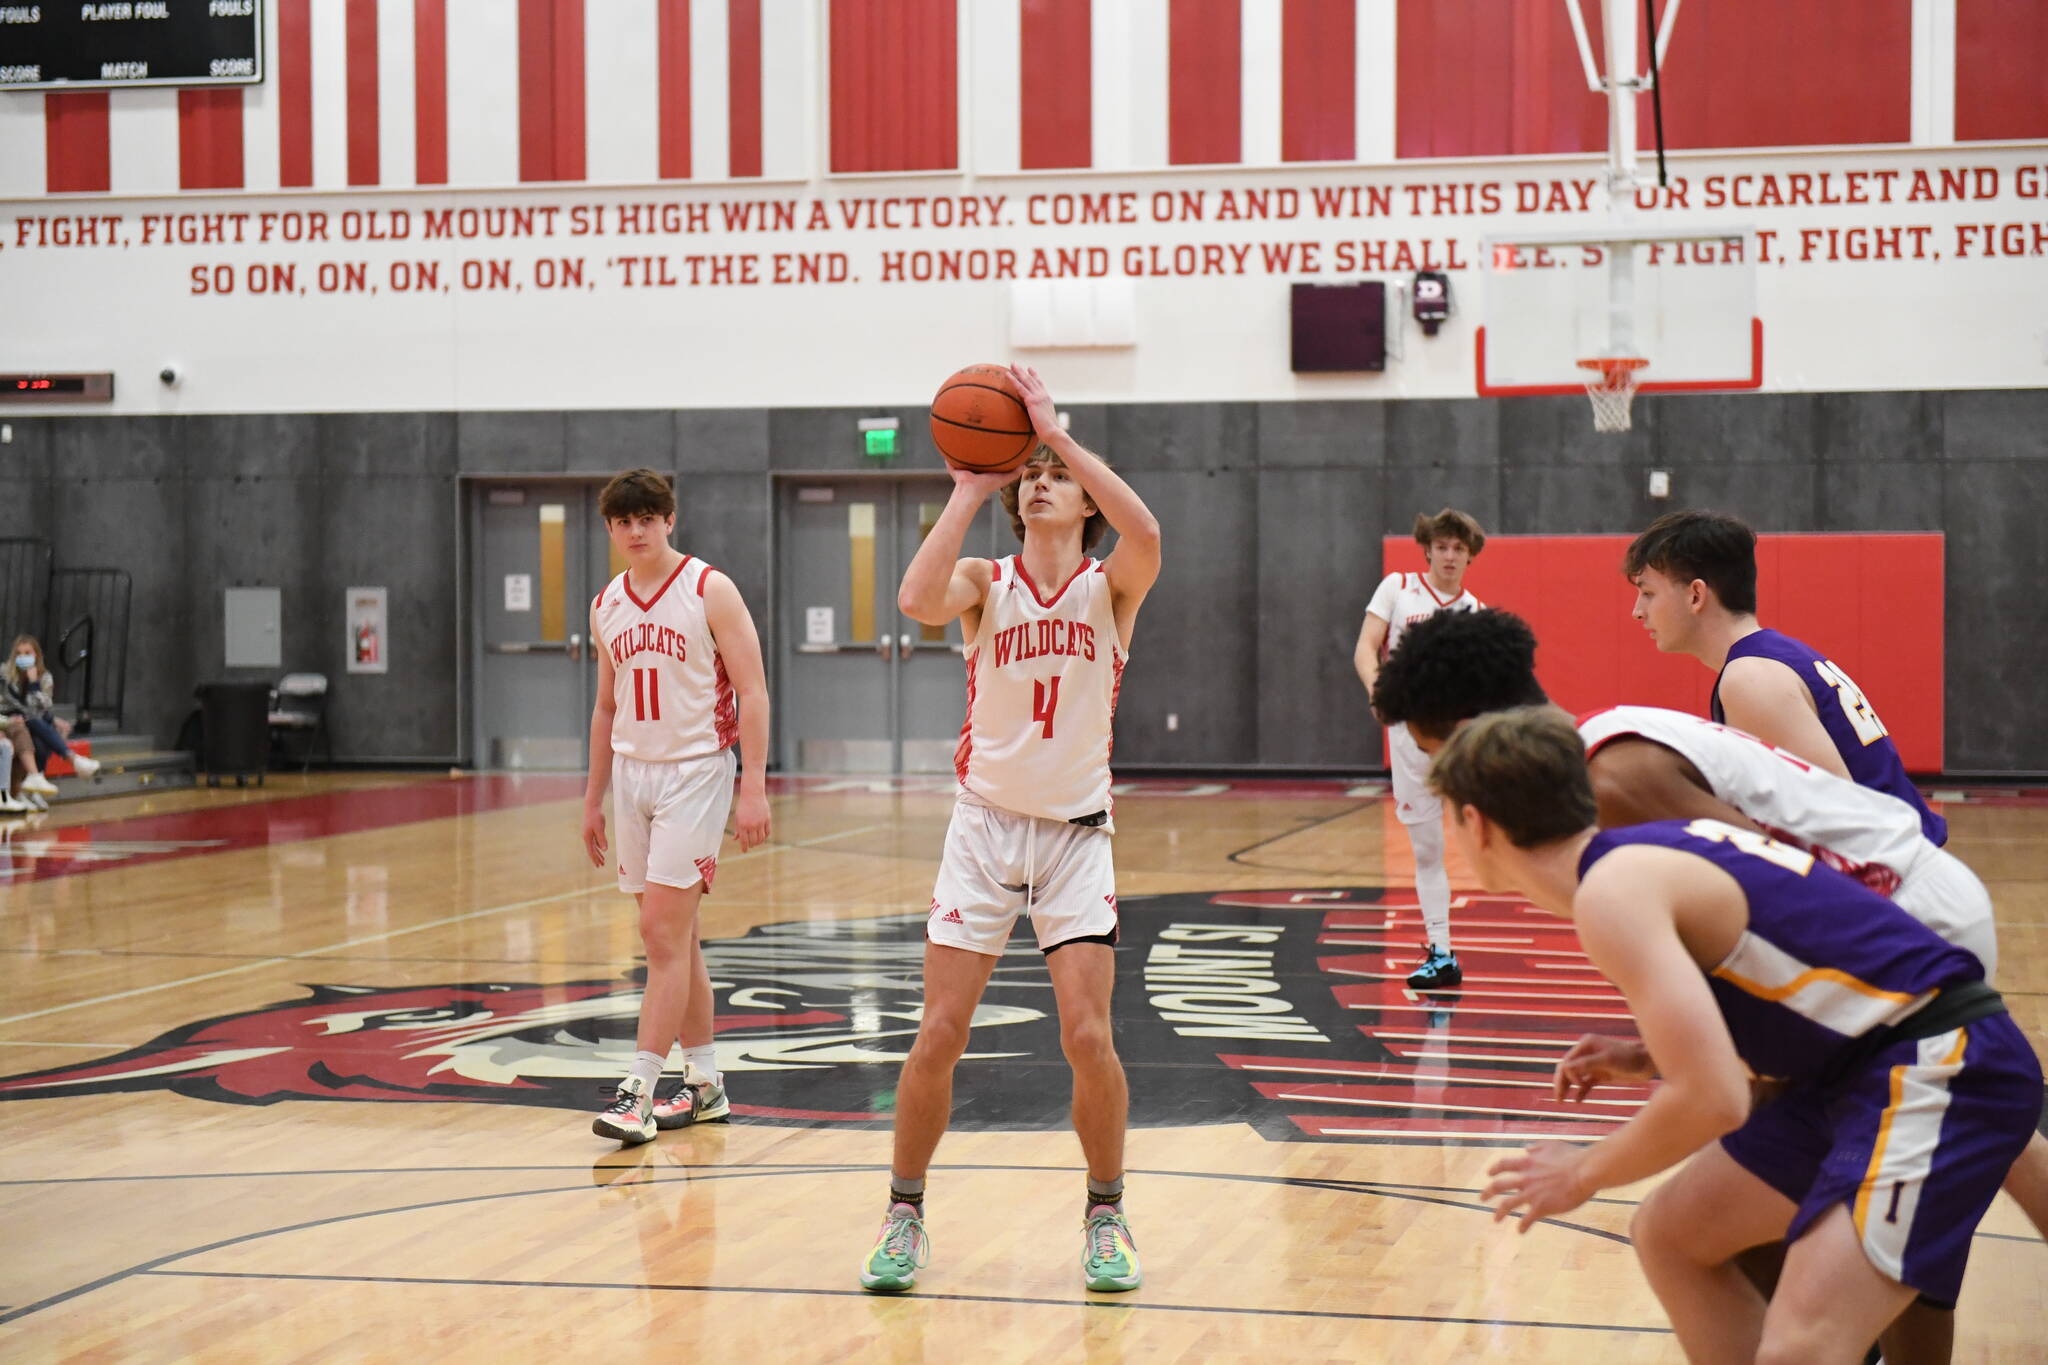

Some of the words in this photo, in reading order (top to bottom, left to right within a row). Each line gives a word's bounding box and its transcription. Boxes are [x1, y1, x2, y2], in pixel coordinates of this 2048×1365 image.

[0, 5, 41, 24] FOULS
[81, 3, 132, 22] PLAYER
[135, 1, 170, 20] FOUL
[208, 0, 254, 17] FOULS
[0, 64, 42, 83] SCORE
[101, 61, 149, 80] MATCH
[209, 58, 255, 78] SCORE
[15, 215, 129, 248] FIGHT,
[141, 213, 249, 245] FIGHT
[259, 211, 329, 242] FOR
[341, 209, 411, 241] OLD
[423, 206, 561, 240] MOUNT
[570, 204, 605, 236] SI
[617, 203, 710, 235] HIGH
[720, 200, 797, 233] WIN
[806, 200, 838, 231] A
[838, 195, 1015, 230] VICTORY.
[1027, 192, 1137, 225] COME
[1151, 190, 1205, 222] ON
[1215, 188, 1300, 221] AND
[1311, 186, 1393, 218] WIN
[1403, 182, 1502, 217] THIS
[1515, 180, 1597, 213] DAY
[1703, 170, 1900, 208] SCARLET
[1907, 166, 2000, 202] AND
[2015, 165, 2048, 199] G
[191, 264, 235, 295] SO
[246, 263, 306, 295] ON,
[318, 263, 378, 293] ON,
[389, 262, 450, 292] ON,
[462, 260, 522, 290] ON,
[534, 258, 594, 289] ON,
[684, 254, 760, 286] THE
[771, 252, 860, 285] END.
[881, 249, 1018, 282] HONOR
[1027, 247, 1110, 279] AND
[1122, 243, 1252, 277] GLORY
[1259, 242, 1321, 274] WE
[1334, 240, 1468, 272] SHALL
[1648, 231, 1787, 265] FIGHT,
[1800, 226, 1941, 262] FIGHT,
[611, 623, 686, 667] WILDCATS
[994, 618, 1096, 668] WILDCATS
[632, 667, 661, 721] 11
[1032, 676, 1062, 739] 4
[1158, 922, 1287, 944] SI
[1143, 944, 1332, 1042] MOUNT
